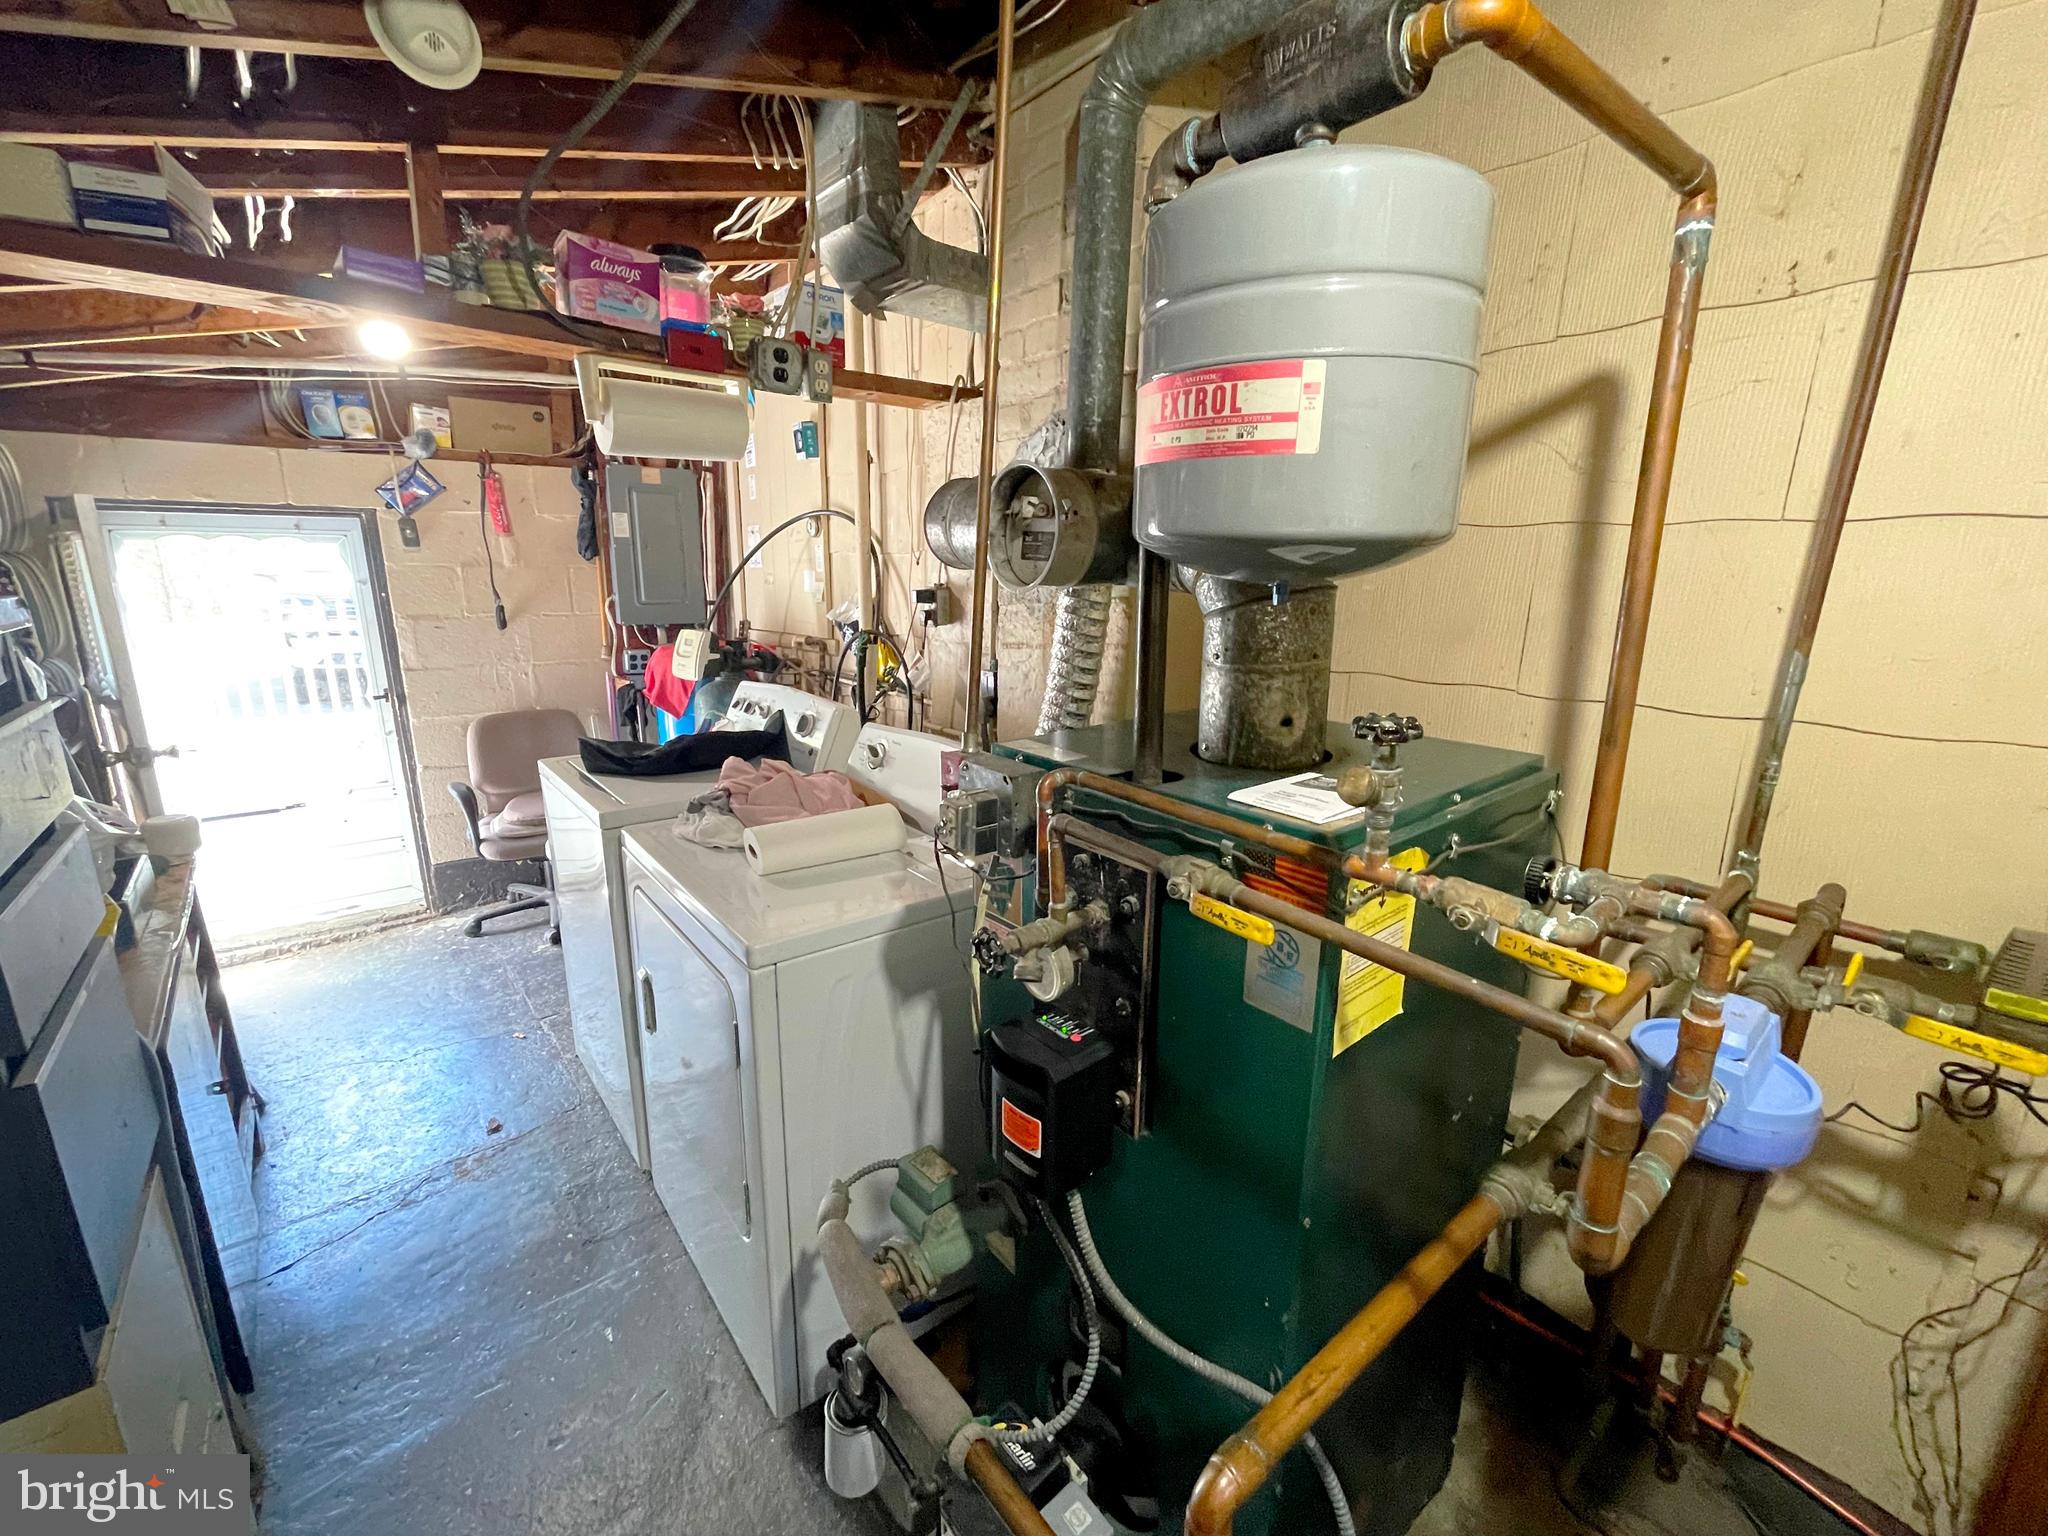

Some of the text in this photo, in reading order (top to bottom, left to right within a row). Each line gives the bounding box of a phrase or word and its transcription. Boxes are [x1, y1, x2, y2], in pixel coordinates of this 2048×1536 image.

[590, 256, 642, 284] always
[1160, 382, 1242, 423] EXTROL
[1214, 416, 1242, 424] HEATING
